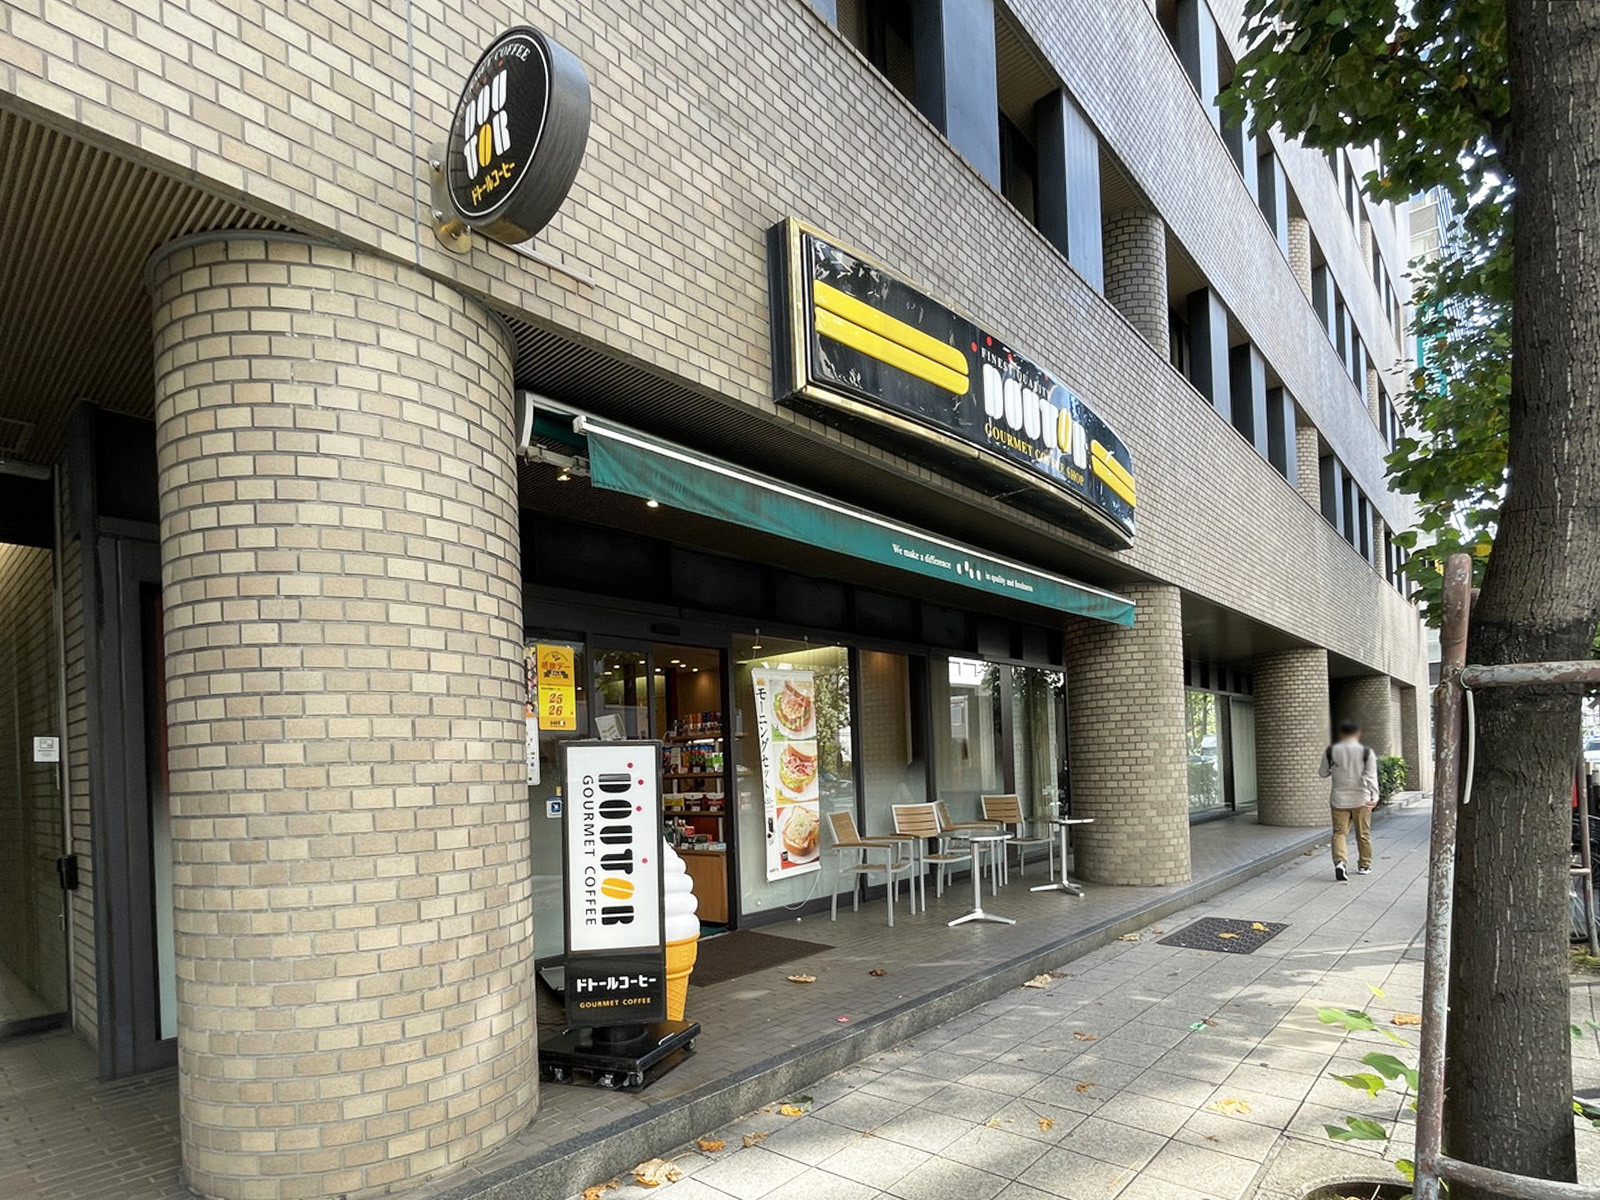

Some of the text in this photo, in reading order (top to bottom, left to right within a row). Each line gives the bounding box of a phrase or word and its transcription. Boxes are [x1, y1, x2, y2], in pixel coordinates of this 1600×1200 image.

[471, 162, 515, 206] ドトールコーヒー
[982, 363, 1087, 470] DOUTOR
[984, 421, 1033, 457] GOURMET
[1066, 466, 1084, 486] SHOP
[892, 543, 903, 555] We
[903, 549, 919, 560] make
[925, 554, 951, 569] difference
[548, 705, 563, 716] 26
[549, 693, 563, 704] 25
[756, 687, 769, 795] モーニングセット
[582, 775, 597, 926] GOURMET COFFEE
[598, 773, 635, 926] DOUTOR
[576, 974, 657, 993] ドトールコーヒー
[579, 996, 652, 1009] GOURMET COFFEE
